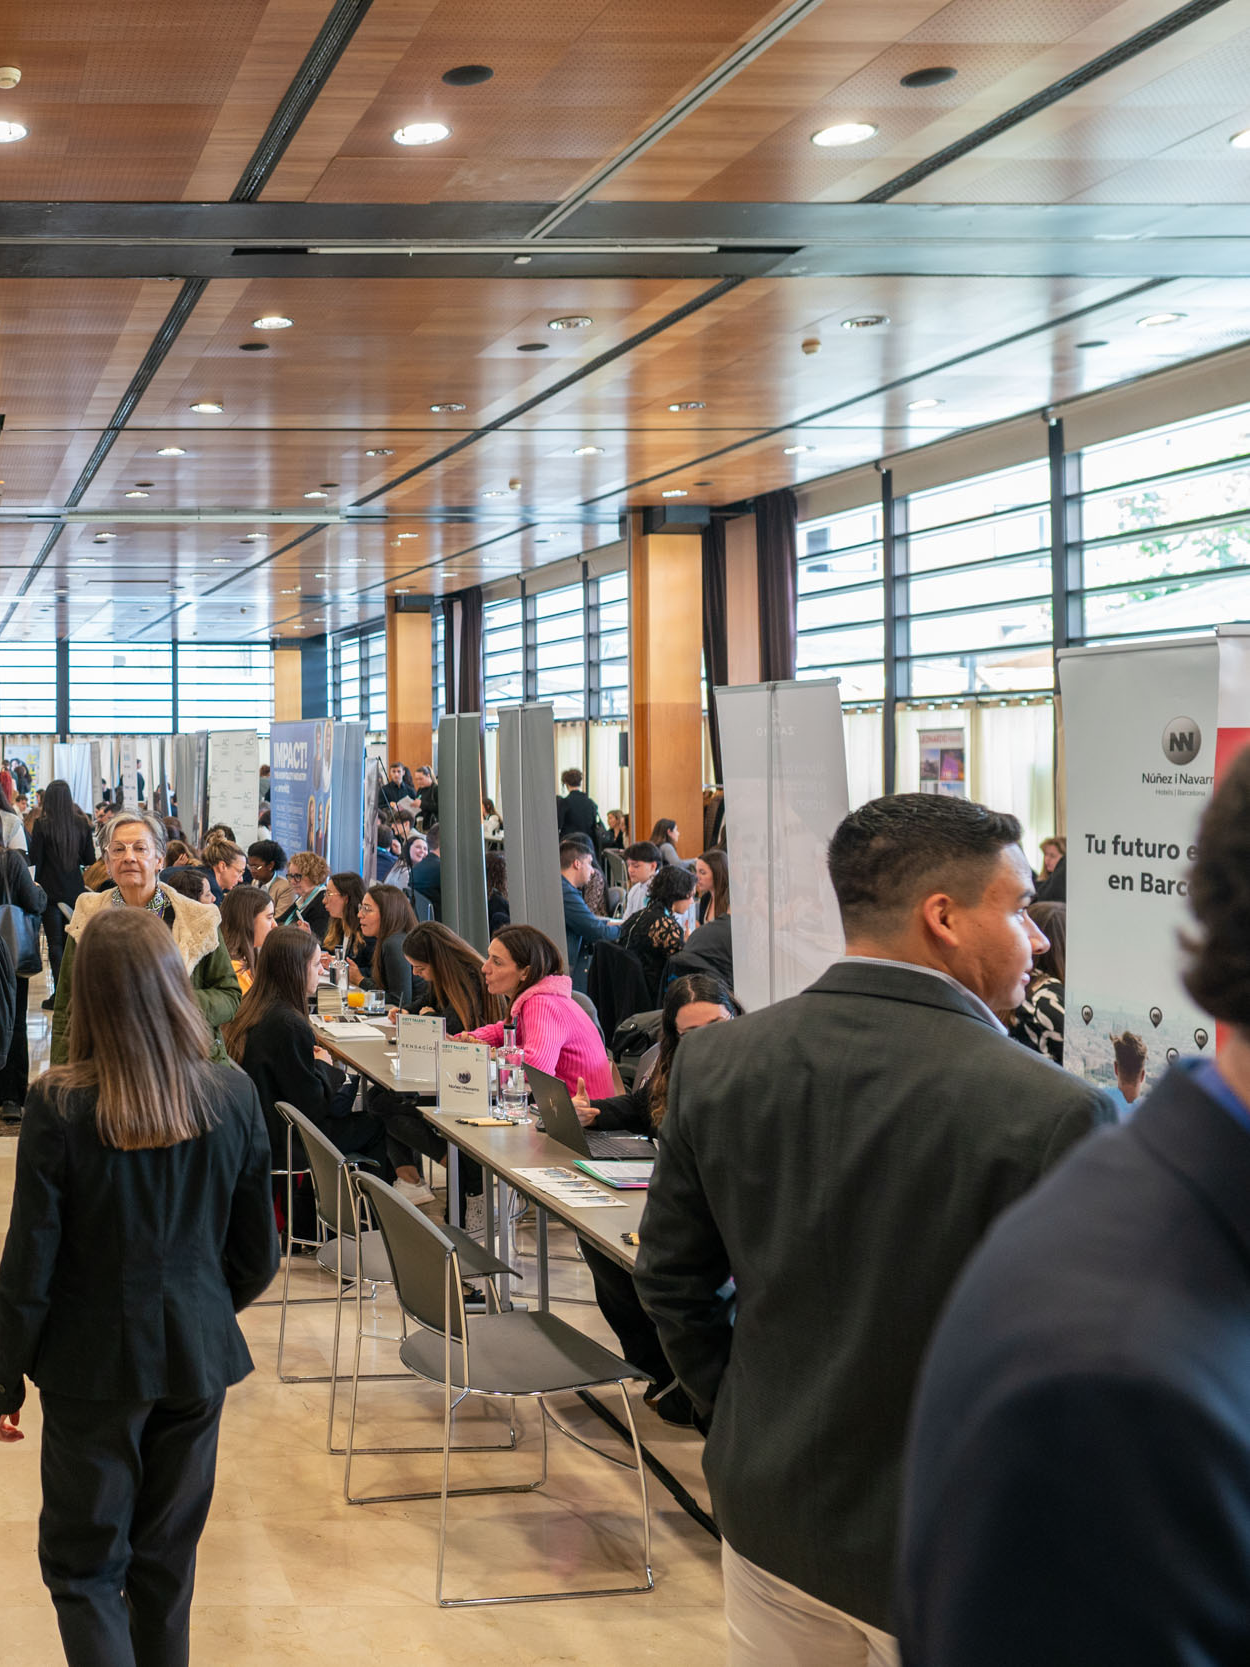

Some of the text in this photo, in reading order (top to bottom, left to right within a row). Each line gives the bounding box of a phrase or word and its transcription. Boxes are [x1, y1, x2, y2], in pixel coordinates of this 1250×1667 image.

[273, 742, 308, 770] IMPACT!
[1142, 772, 1214, 784] Núñez i Navarr
[1177, 789, 1206, 797] Barcelona
[1085, 834, 1106, 854] Tu
[1112, 834, 1180, 860] futuro
[1108, 872, 1189, 896] en Barc
